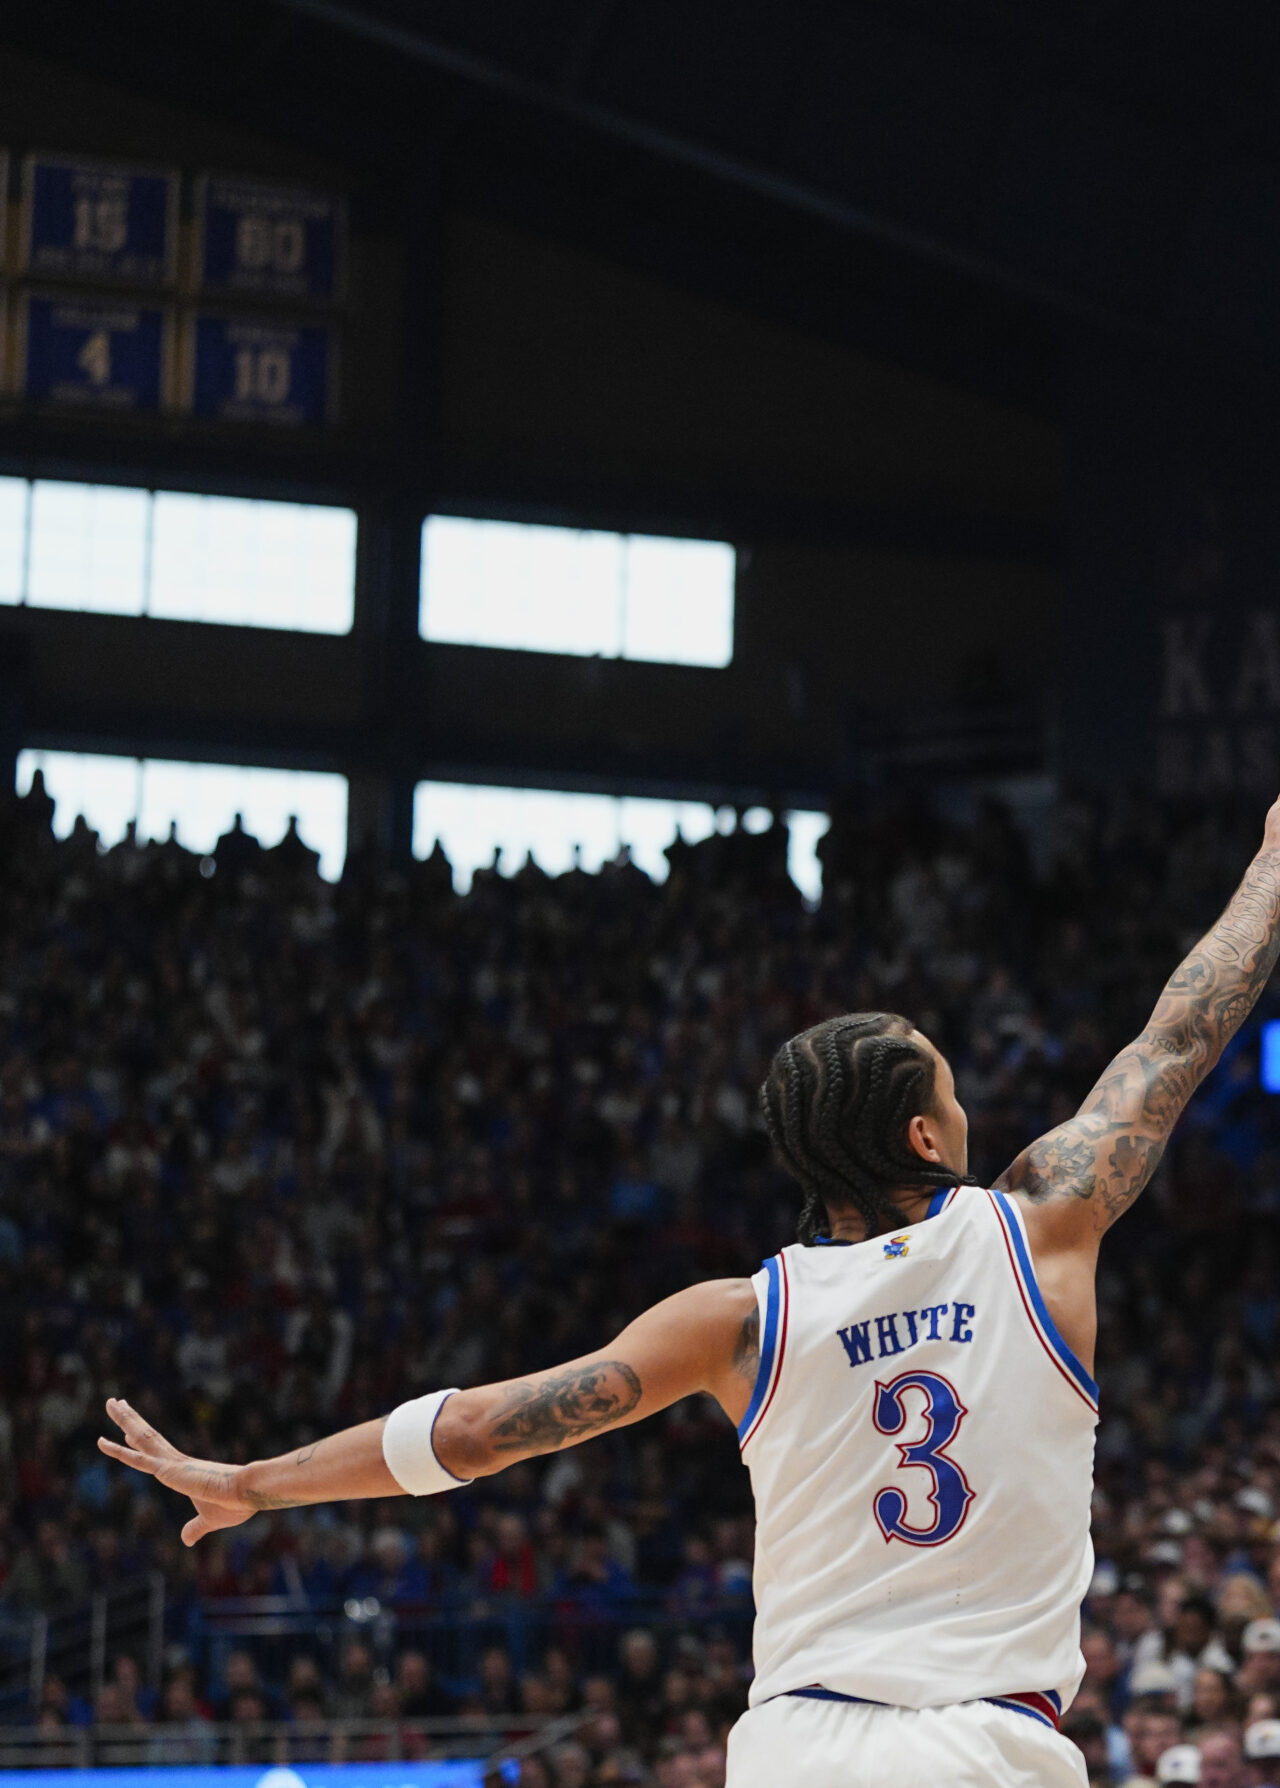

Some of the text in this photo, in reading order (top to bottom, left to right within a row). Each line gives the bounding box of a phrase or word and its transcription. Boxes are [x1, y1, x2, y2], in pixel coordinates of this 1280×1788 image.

[78, 329, 112, 386] 4
[234, 349, 291, 404] 10
[836, 1301, 976, 1368] WHITE
[872, 1369, 978, 1548] 3
